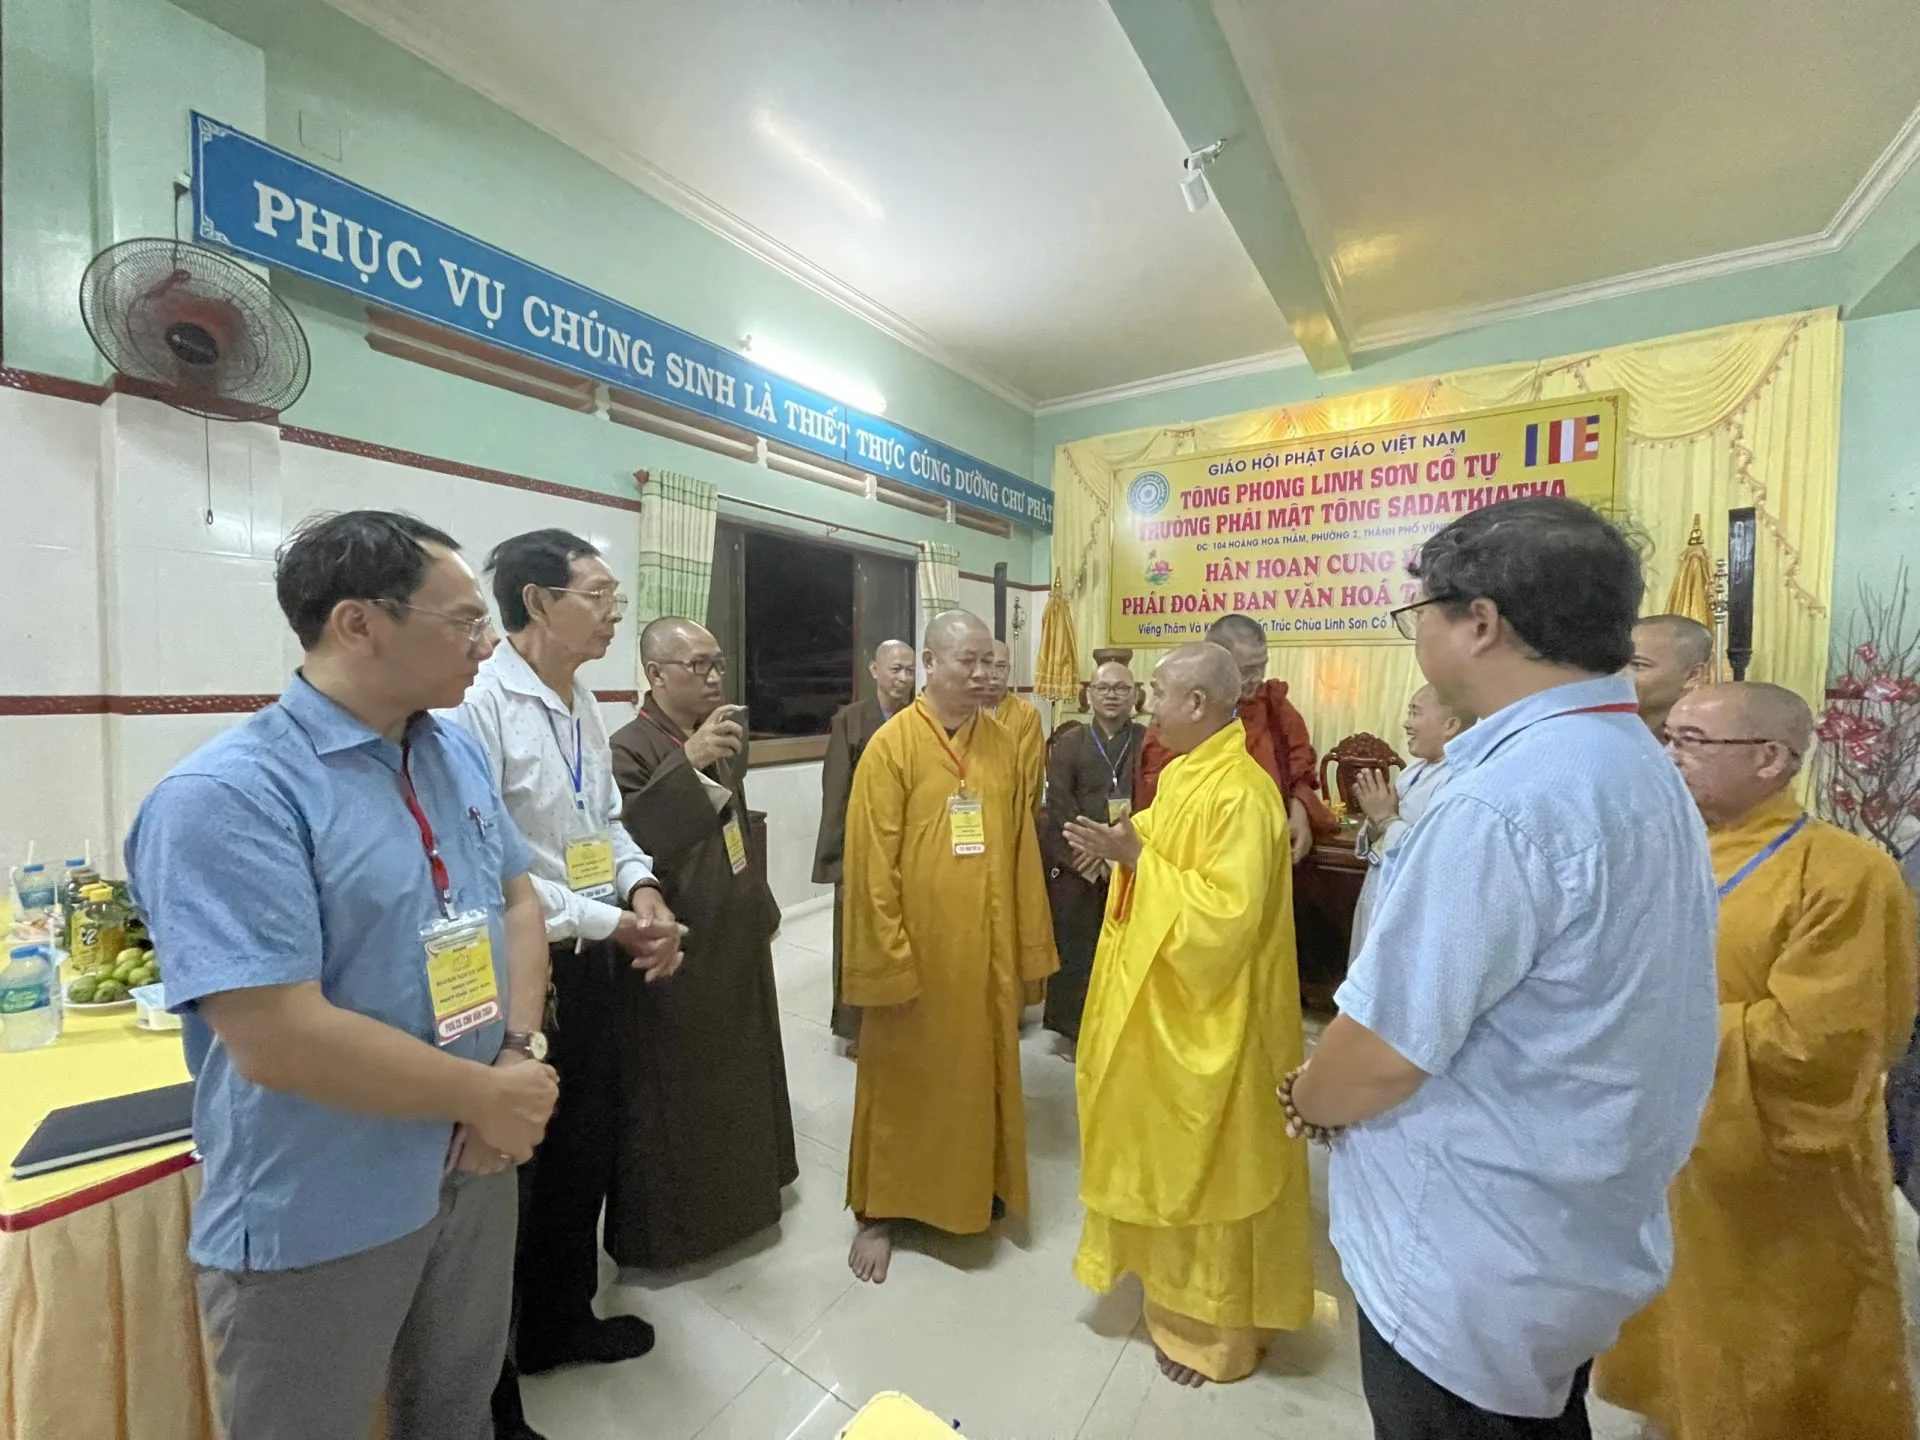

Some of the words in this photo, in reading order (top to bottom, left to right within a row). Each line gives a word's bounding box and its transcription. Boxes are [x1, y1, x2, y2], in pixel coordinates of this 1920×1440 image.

[253, 180, 424, 291] PHỤC
[439, 257, 505, 330] VỤ
[522, 295, 656, 380] CHÚNG
[666, 351, 736, 408] SINH
[744, 381, 778, 424] LÀ
[784, 399, 851, 449] THIẾT
[856, 428, 906, 472] THỰC
[909, 448, 951, 487] CÚNG
[954, 467, 999, 505] DƯỜNG
[1001, 485, 1026, 513] CHƯ
[1027, 495, 1053, 527] PHẬT
[1208, 455, 1247, 477] GIÁO
[1251, 452, 1279, 472] HỘI
[1284, 448, 1325, 467] PHẬT
[1330, 440, 1376, 460] GIÁO
[1381, 433, 1417, 455] VIỆT
[1422, 429, 1466, 448] NAM
[1180, 485, 1230, 510] TÔNG
[1235, 476, 1305, 505] PHONG
[1311, 468, 1364, 496] LINH
[1370, 462, 1419, 489] SƠN
[1426, 447, 1456, 482] CỔ
[1464, 451, 1502, 481] TỰ
[1215, 507, 1262, 534] PHÁI
[1267, 502, 1315, 532] MẬT
[1321, 497, 1381, 524] TÔNG
[1213, 540, 1227, 551] 104
[1261, 536, 1280, 546] HOA
[1205, 556, 1250, 582] HÂN
[1256, 554, 1322, 580] HOAN
[1326, 550, 1396, 576] CUNG
[1121, 591, 1165, 615] PHÁI
[1170, 588, 1227, 614] ĐOÀN
[1233, 589, 1278, 611] BAN
[1284, 581, 1334, 610] VĂN
[1340, 578, 1393, 607] HOÁ
[1138, 621, 1161, 637] Viếng
[1190, 621, 1201, 633] Và
[1271, 618, 1291, 631] Trúc
[1294, 617, 1322, 631] Chùa
[1325, 617, 1345, 630] Linh
[1348, 617, 1368, 630] Sơn
